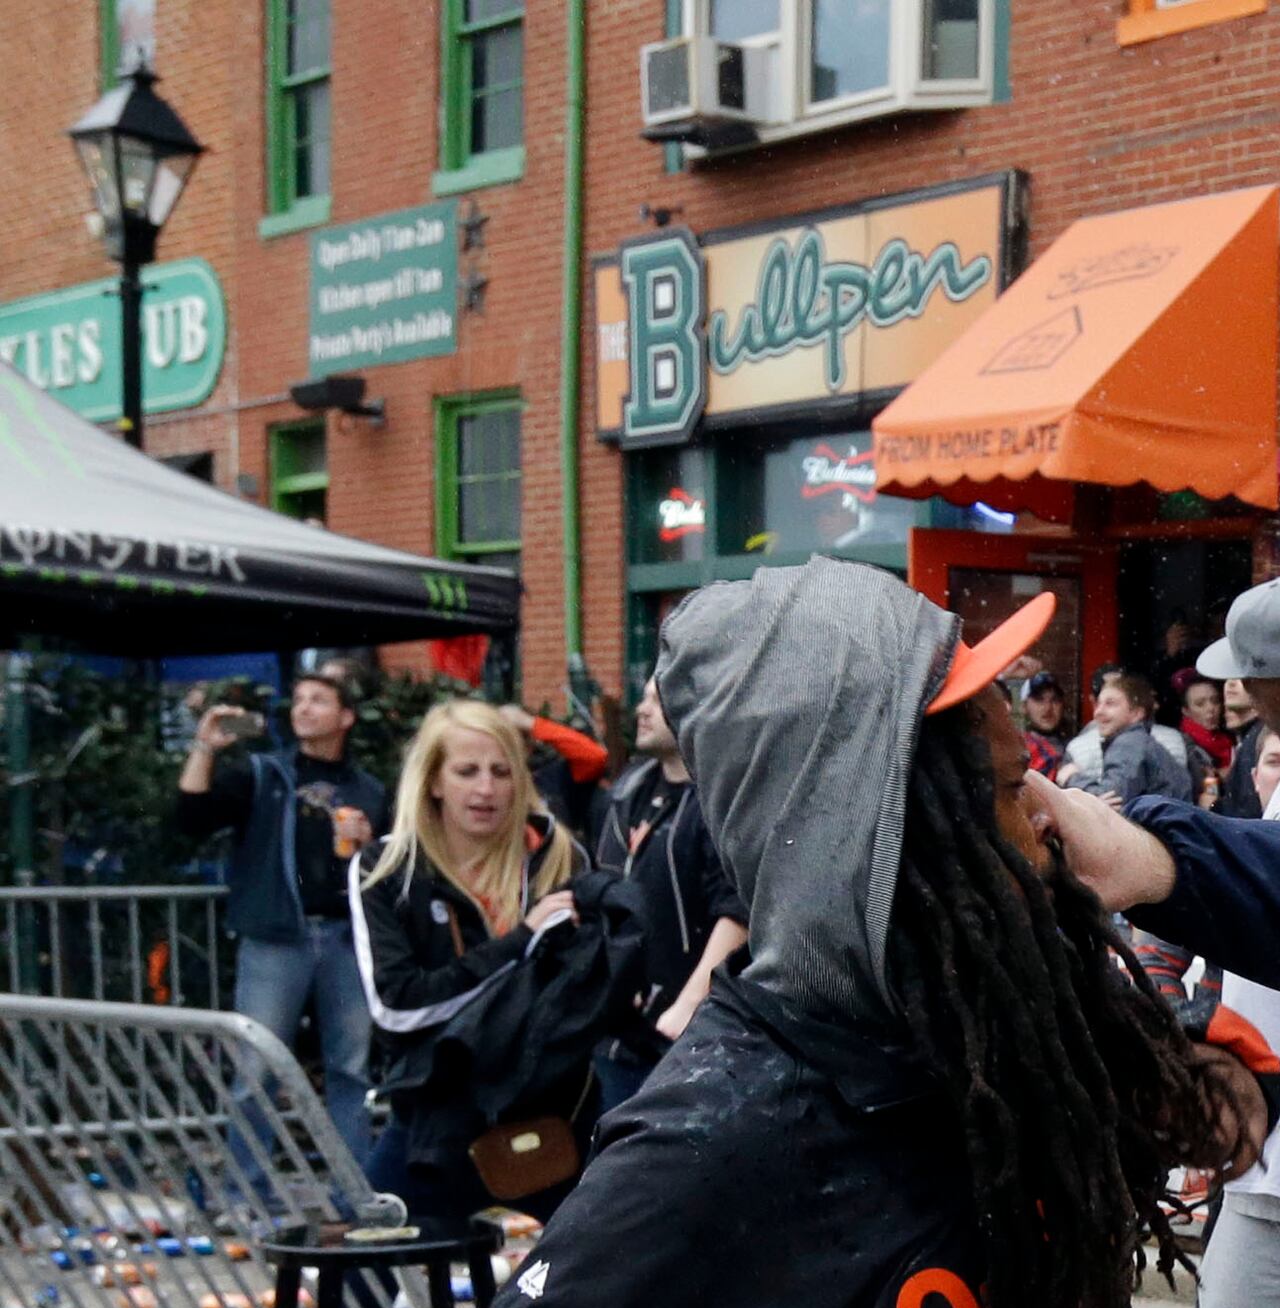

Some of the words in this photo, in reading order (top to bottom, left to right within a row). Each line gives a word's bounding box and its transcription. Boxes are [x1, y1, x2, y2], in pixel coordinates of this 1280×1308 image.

[143, 296, 208, 369] UB
[622, 225, 990, 440] Bullpen
[879, 434, 931, 463] FROM
[936, 429, 994, 460] HOME
[999, 422, 1062, 456] PLATE
